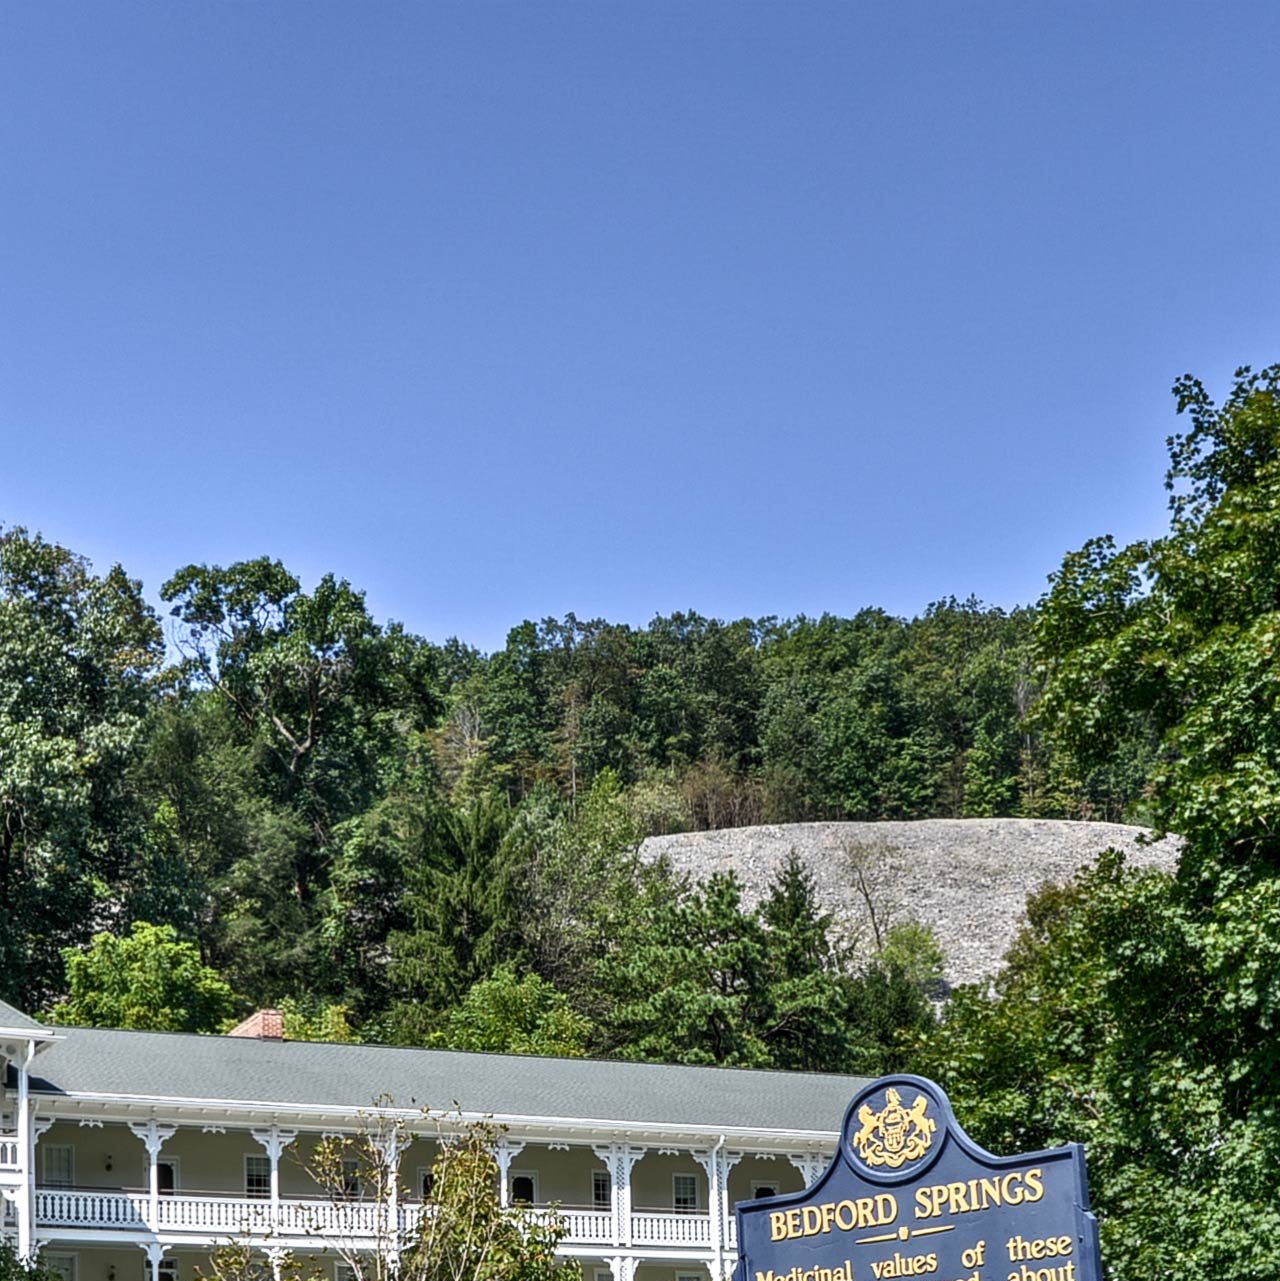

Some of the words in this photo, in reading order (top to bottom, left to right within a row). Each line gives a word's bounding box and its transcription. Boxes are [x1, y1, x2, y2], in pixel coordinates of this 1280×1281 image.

[769, 1194, 899, 1242] BEDFORD
[915, 1169, 1044, 1218] SPRINGS
[871, 1253, 938, 1278] values
[962, 1242, 985, 1268] of
[1006, 1235, 1072, 1261] these
